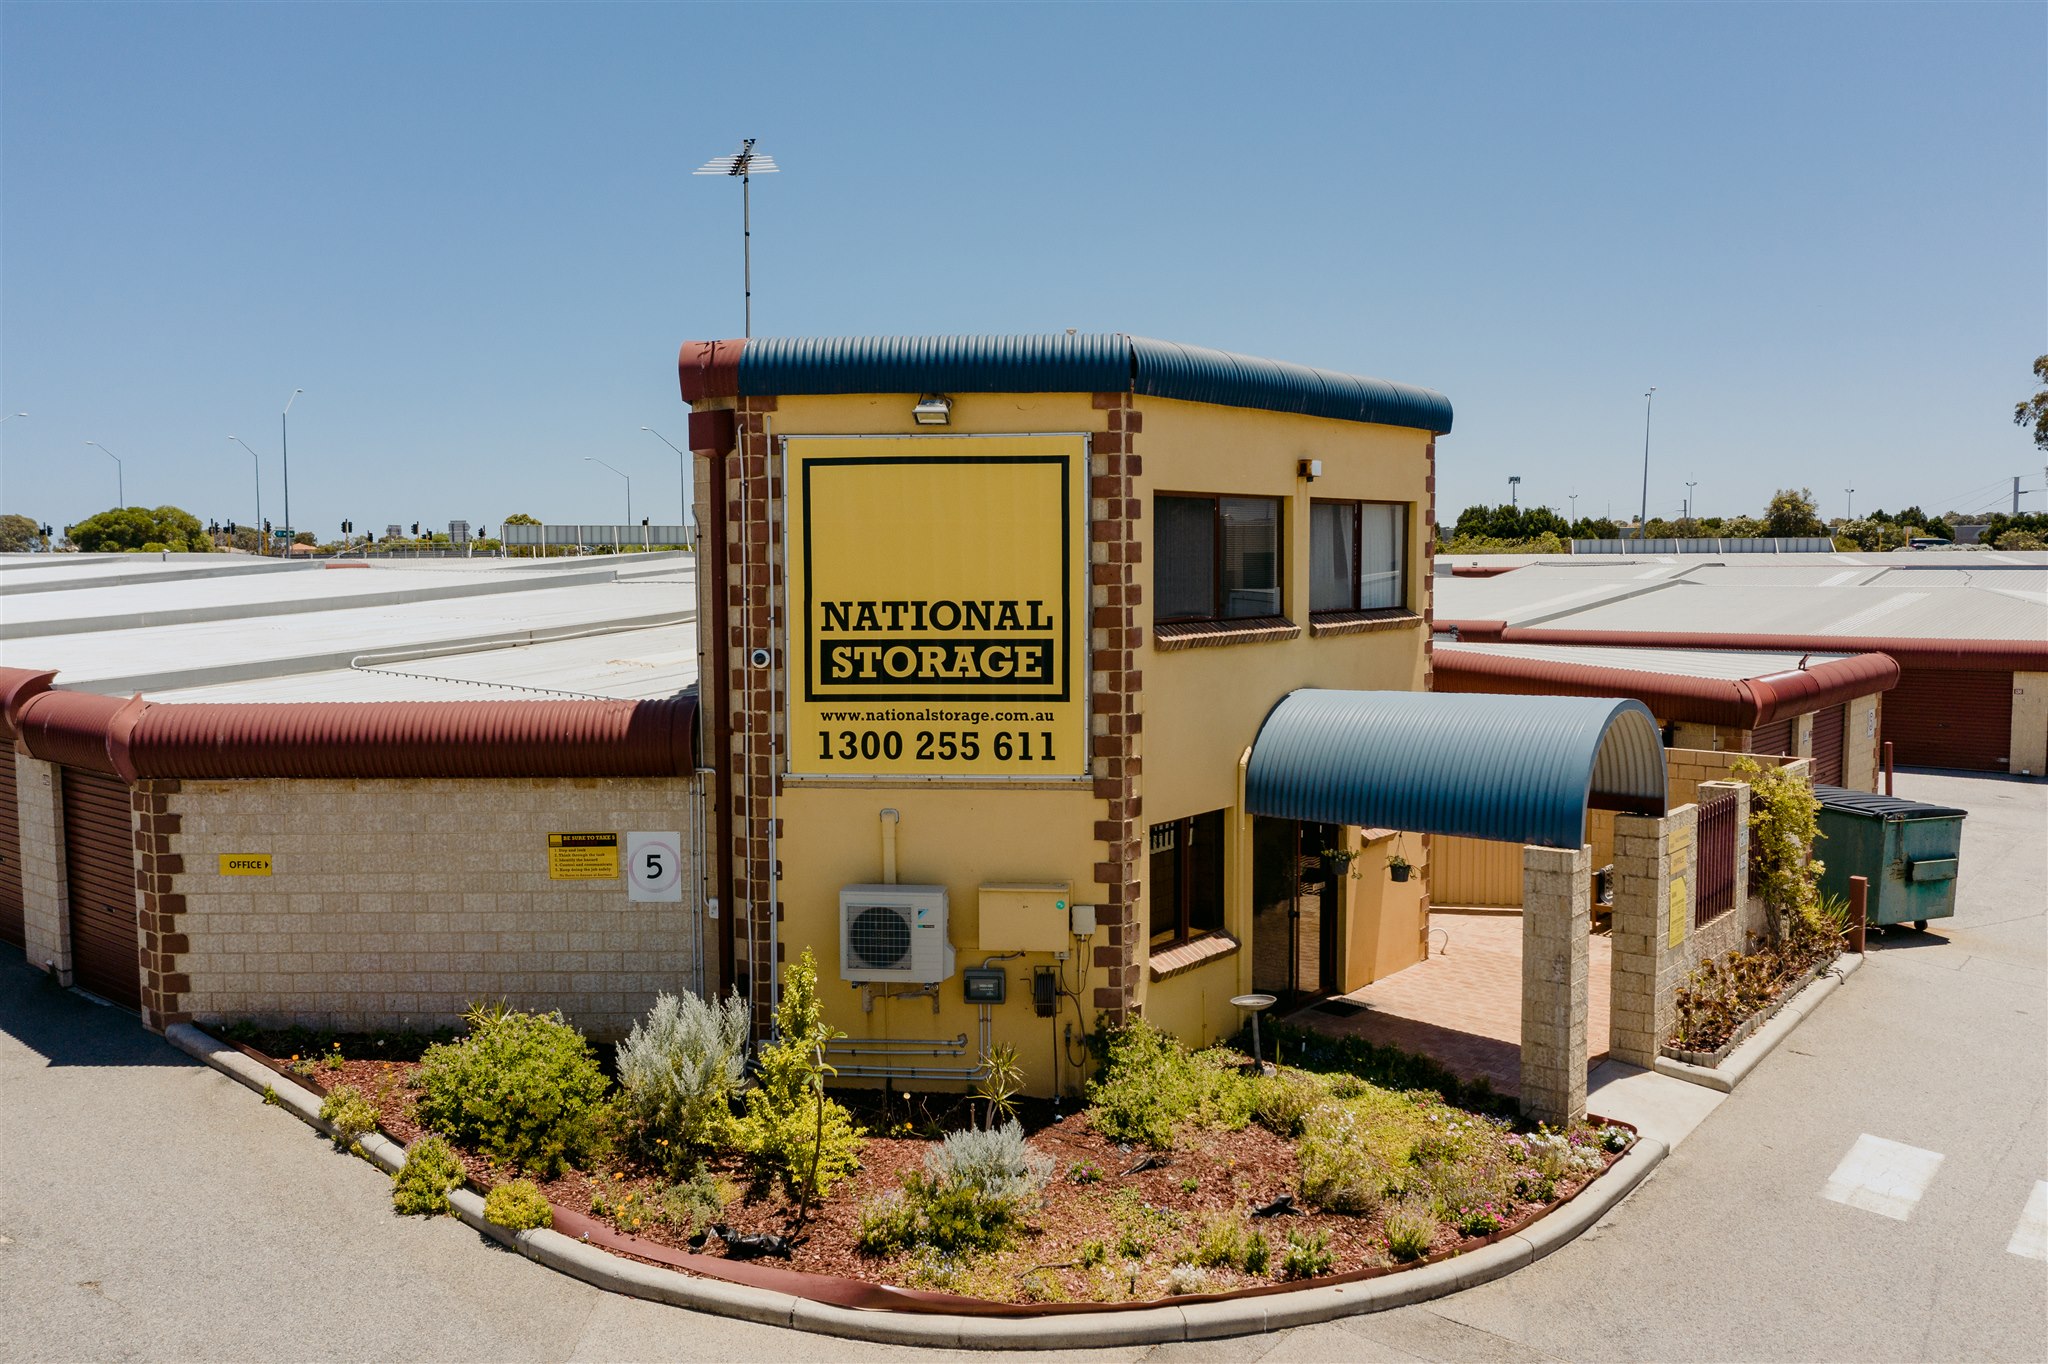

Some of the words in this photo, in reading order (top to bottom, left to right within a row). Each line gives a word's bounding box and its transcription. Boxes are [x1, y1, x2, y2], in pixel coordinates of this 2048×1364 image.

[821, 600, 1053, 631] NATIONAL
[832, 646, 1041, 678] STORAGE
[821, 709, 1054, 724] www.nationalstorage.com.au
[819, 731, 902, 759] 1300
[916, 732, 980, 760] 255
[994, 732, 1055, 761] 611
[229, 861, 262, 869] OFFICE
[646, 854, 663, 879] 5
